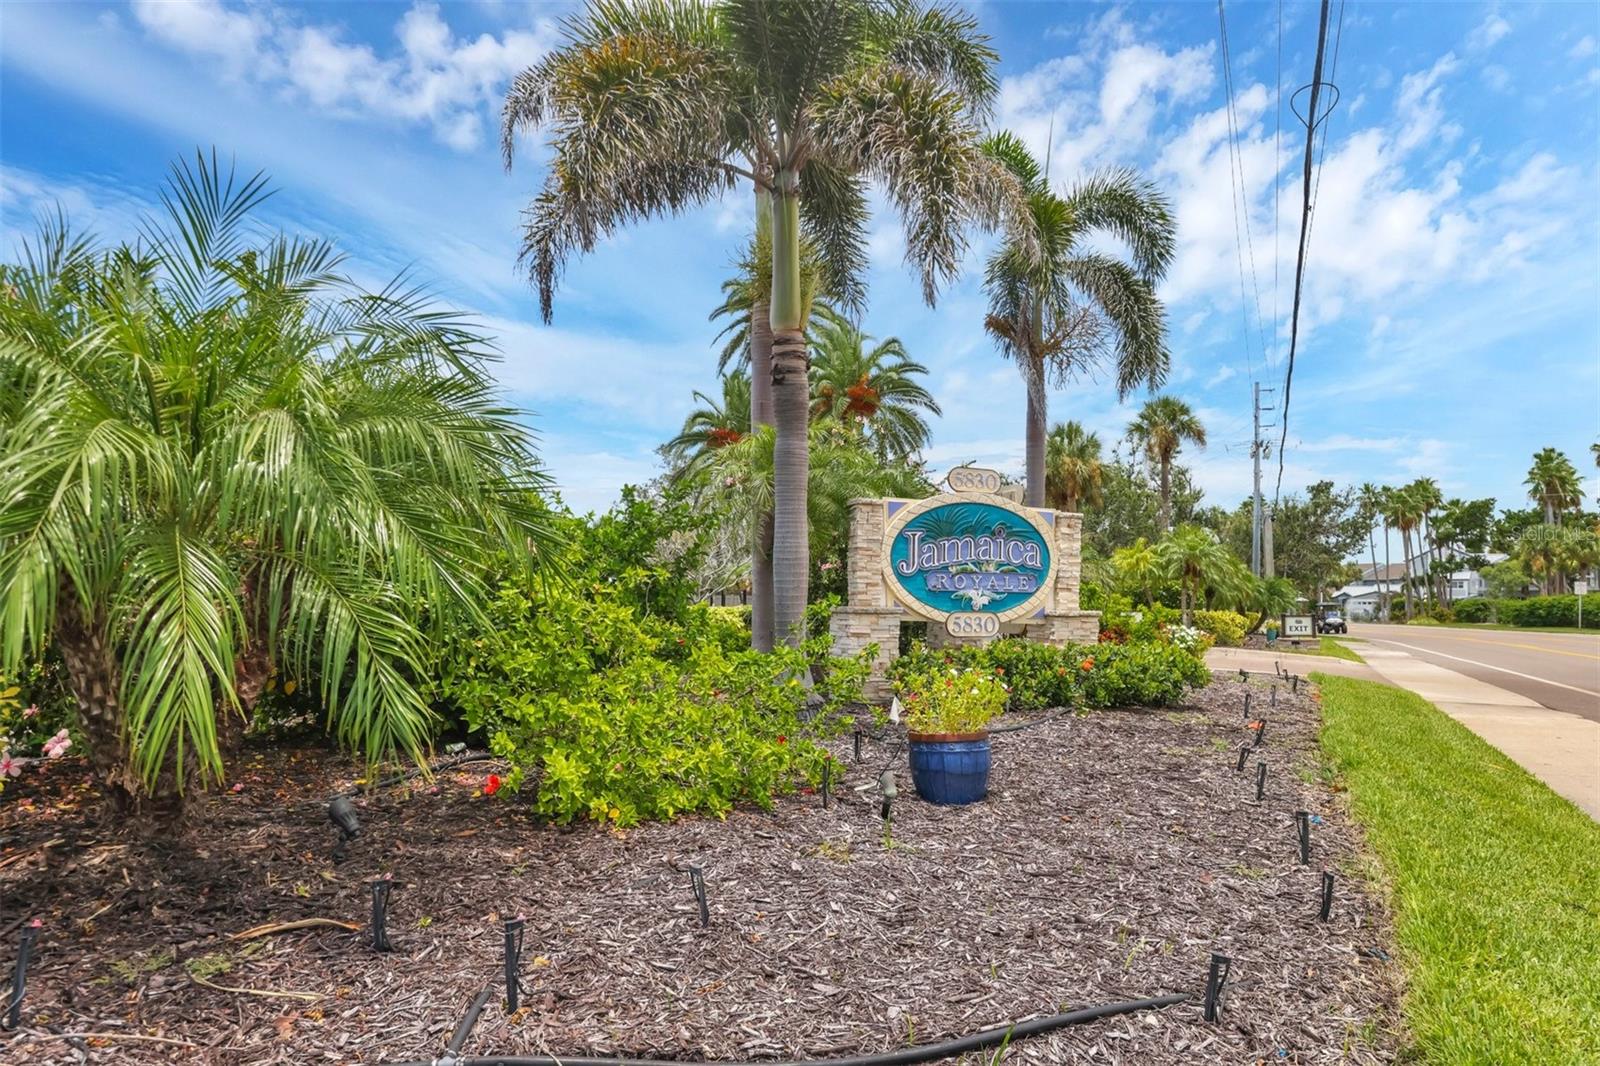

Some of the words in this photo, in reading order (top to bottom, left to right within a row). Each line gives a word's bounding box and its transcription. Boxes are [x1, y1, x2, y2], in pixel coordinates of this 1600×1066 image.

[953, 472, 998, 490] 5830
[899, 527, 1043, 576] Jamaica
[936, 574, 1031, 591] ROYALE
[952, 616, 997, 634] 5830
